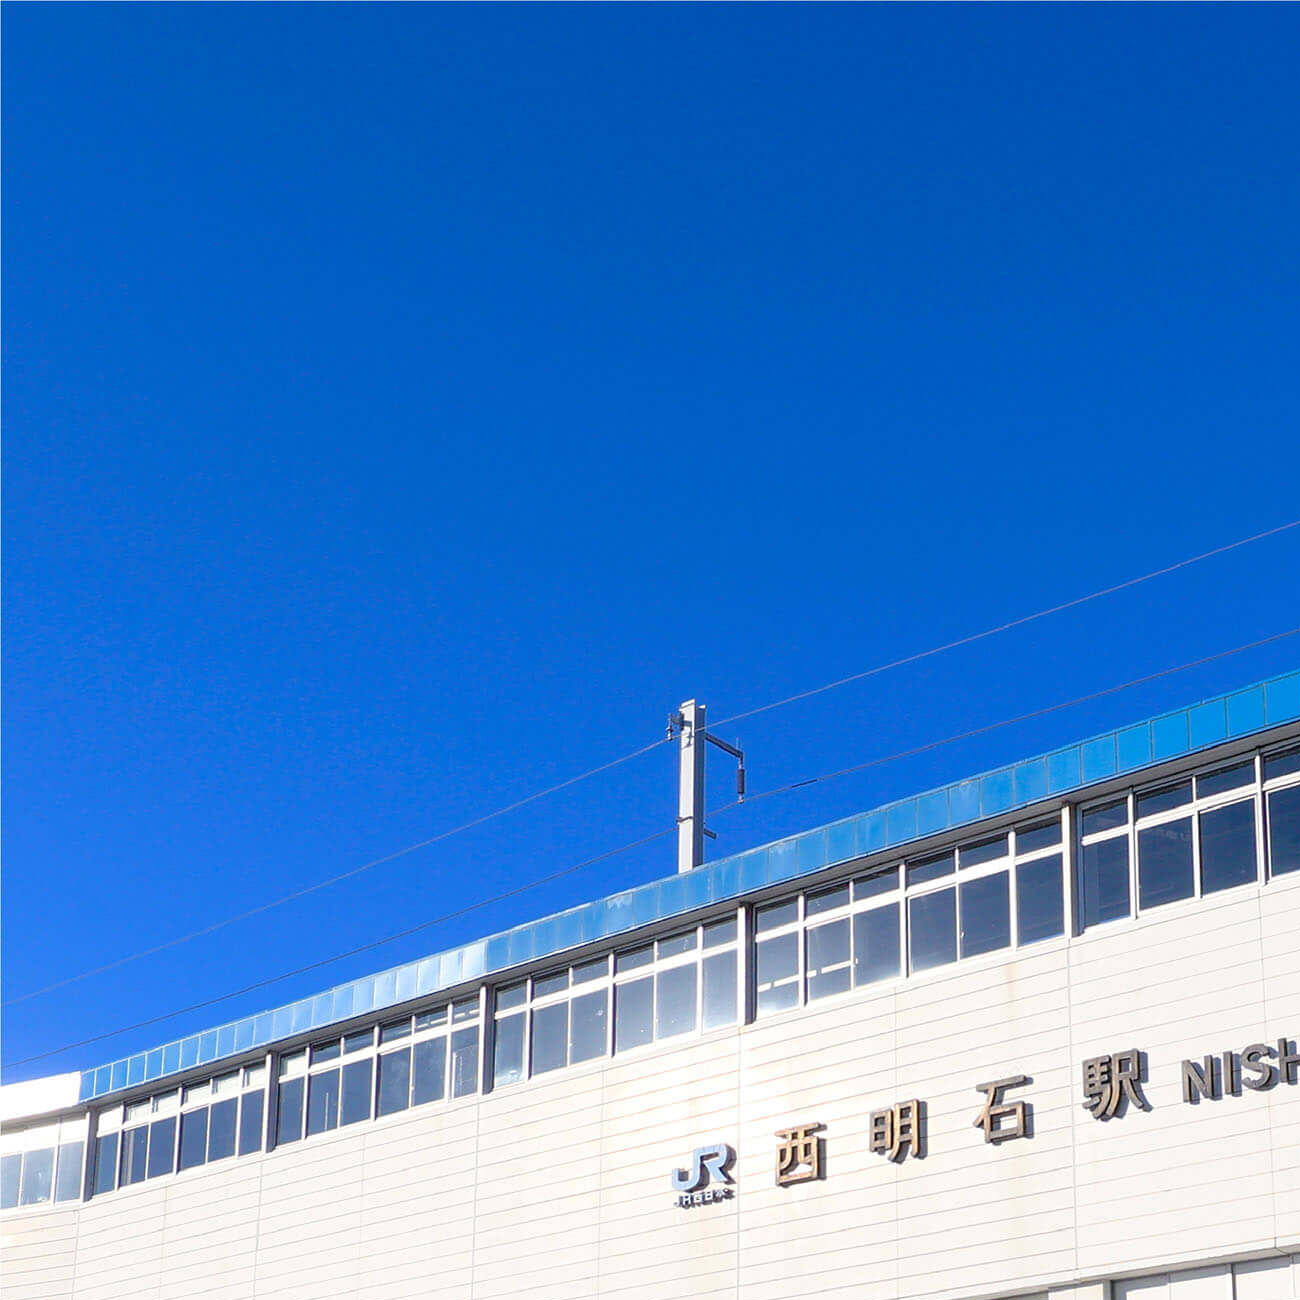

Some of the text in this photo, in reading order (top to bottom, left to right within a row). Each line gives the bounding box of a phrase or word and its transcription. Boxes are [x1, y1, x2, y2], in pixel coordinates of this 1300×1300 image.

[775, 1048, 1153, 1188] 西明石駅
[672, 1143, 737, 1193] JR
